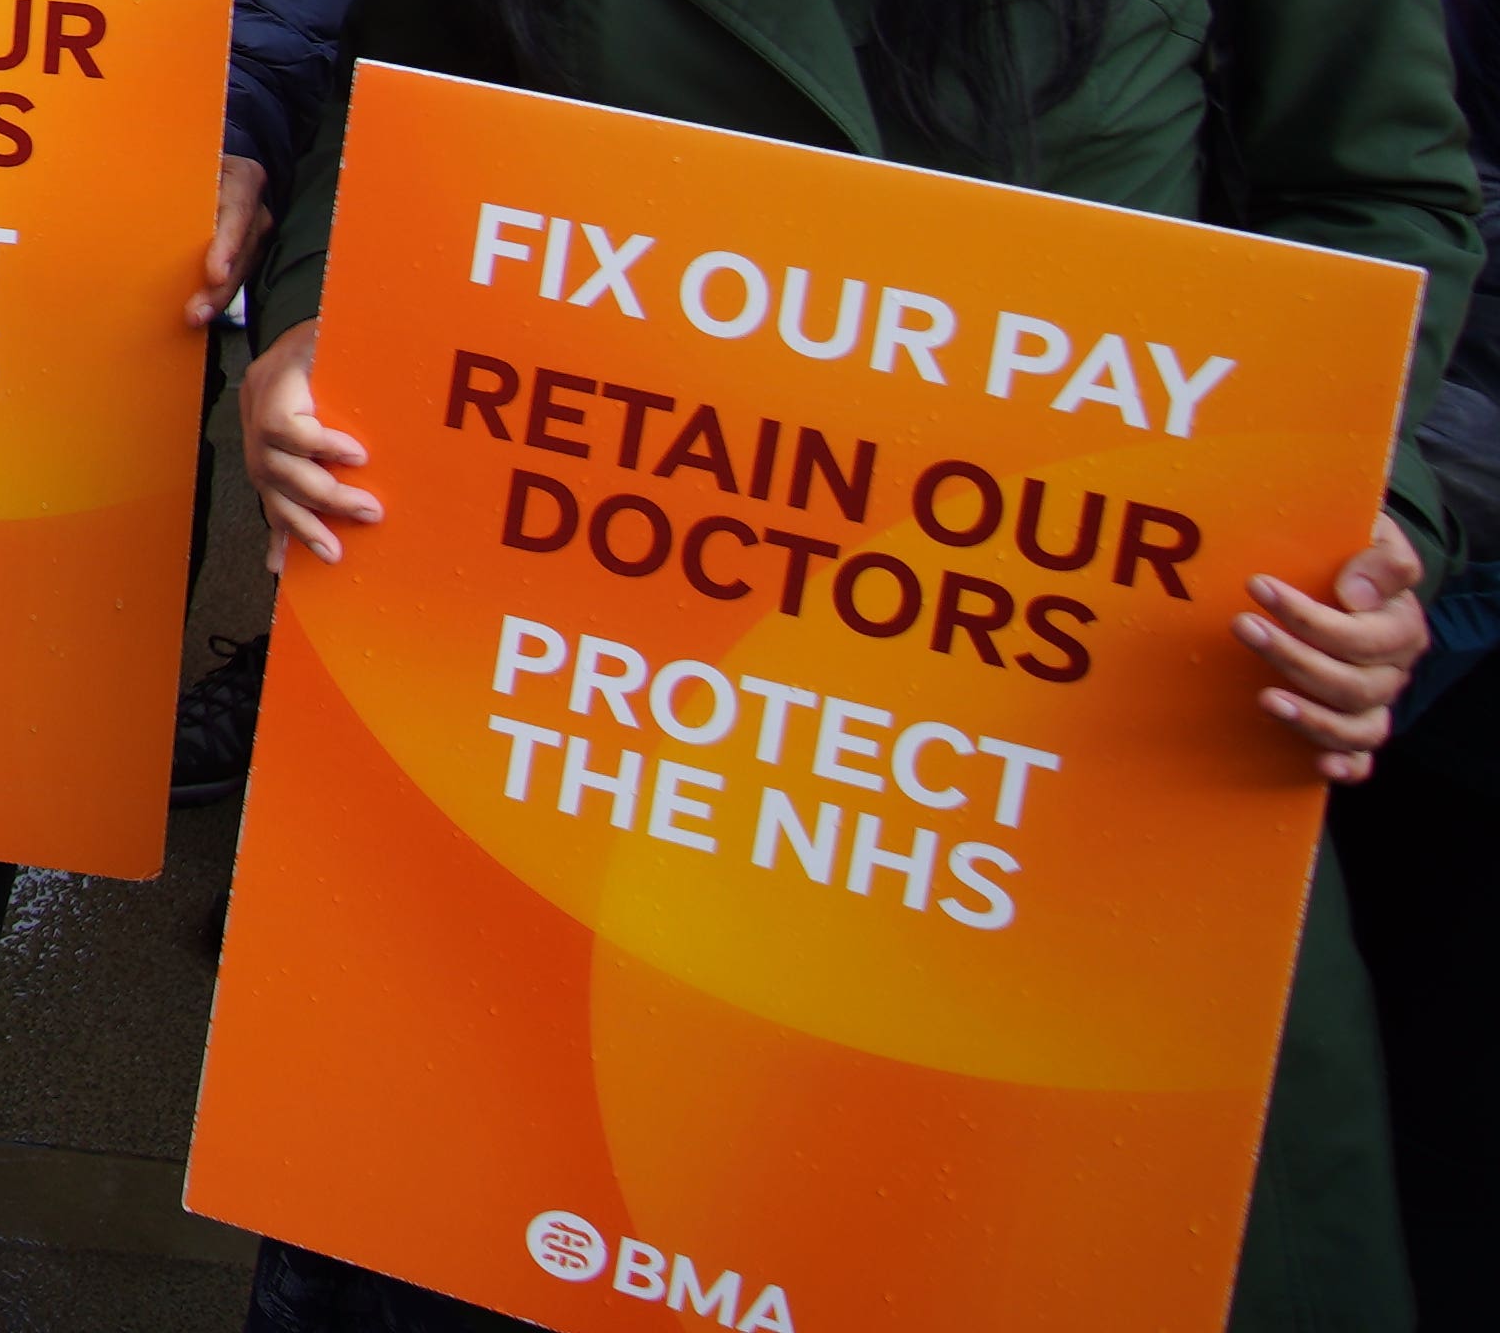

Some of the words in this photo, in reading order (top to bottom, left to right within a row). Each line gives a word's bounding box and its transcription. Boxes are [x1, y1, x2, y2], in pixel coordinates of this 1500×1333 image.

[470, 202, 657, 320] FIX
[680, 250, 958, 386] OUR
[986, 310, 1238, 439] PAY
[444, 349, 878, 524] RETAIN
[913, 460, 1202, 602] OUR
[501, 460, 1108, 686] DOCTORS
[488, 614, 1062, 831] PROTECT
[488, 714, 726, 854] THE
[751, 787, 1022, 931] NHS
[614, 1237, 797, 1333] BMA
